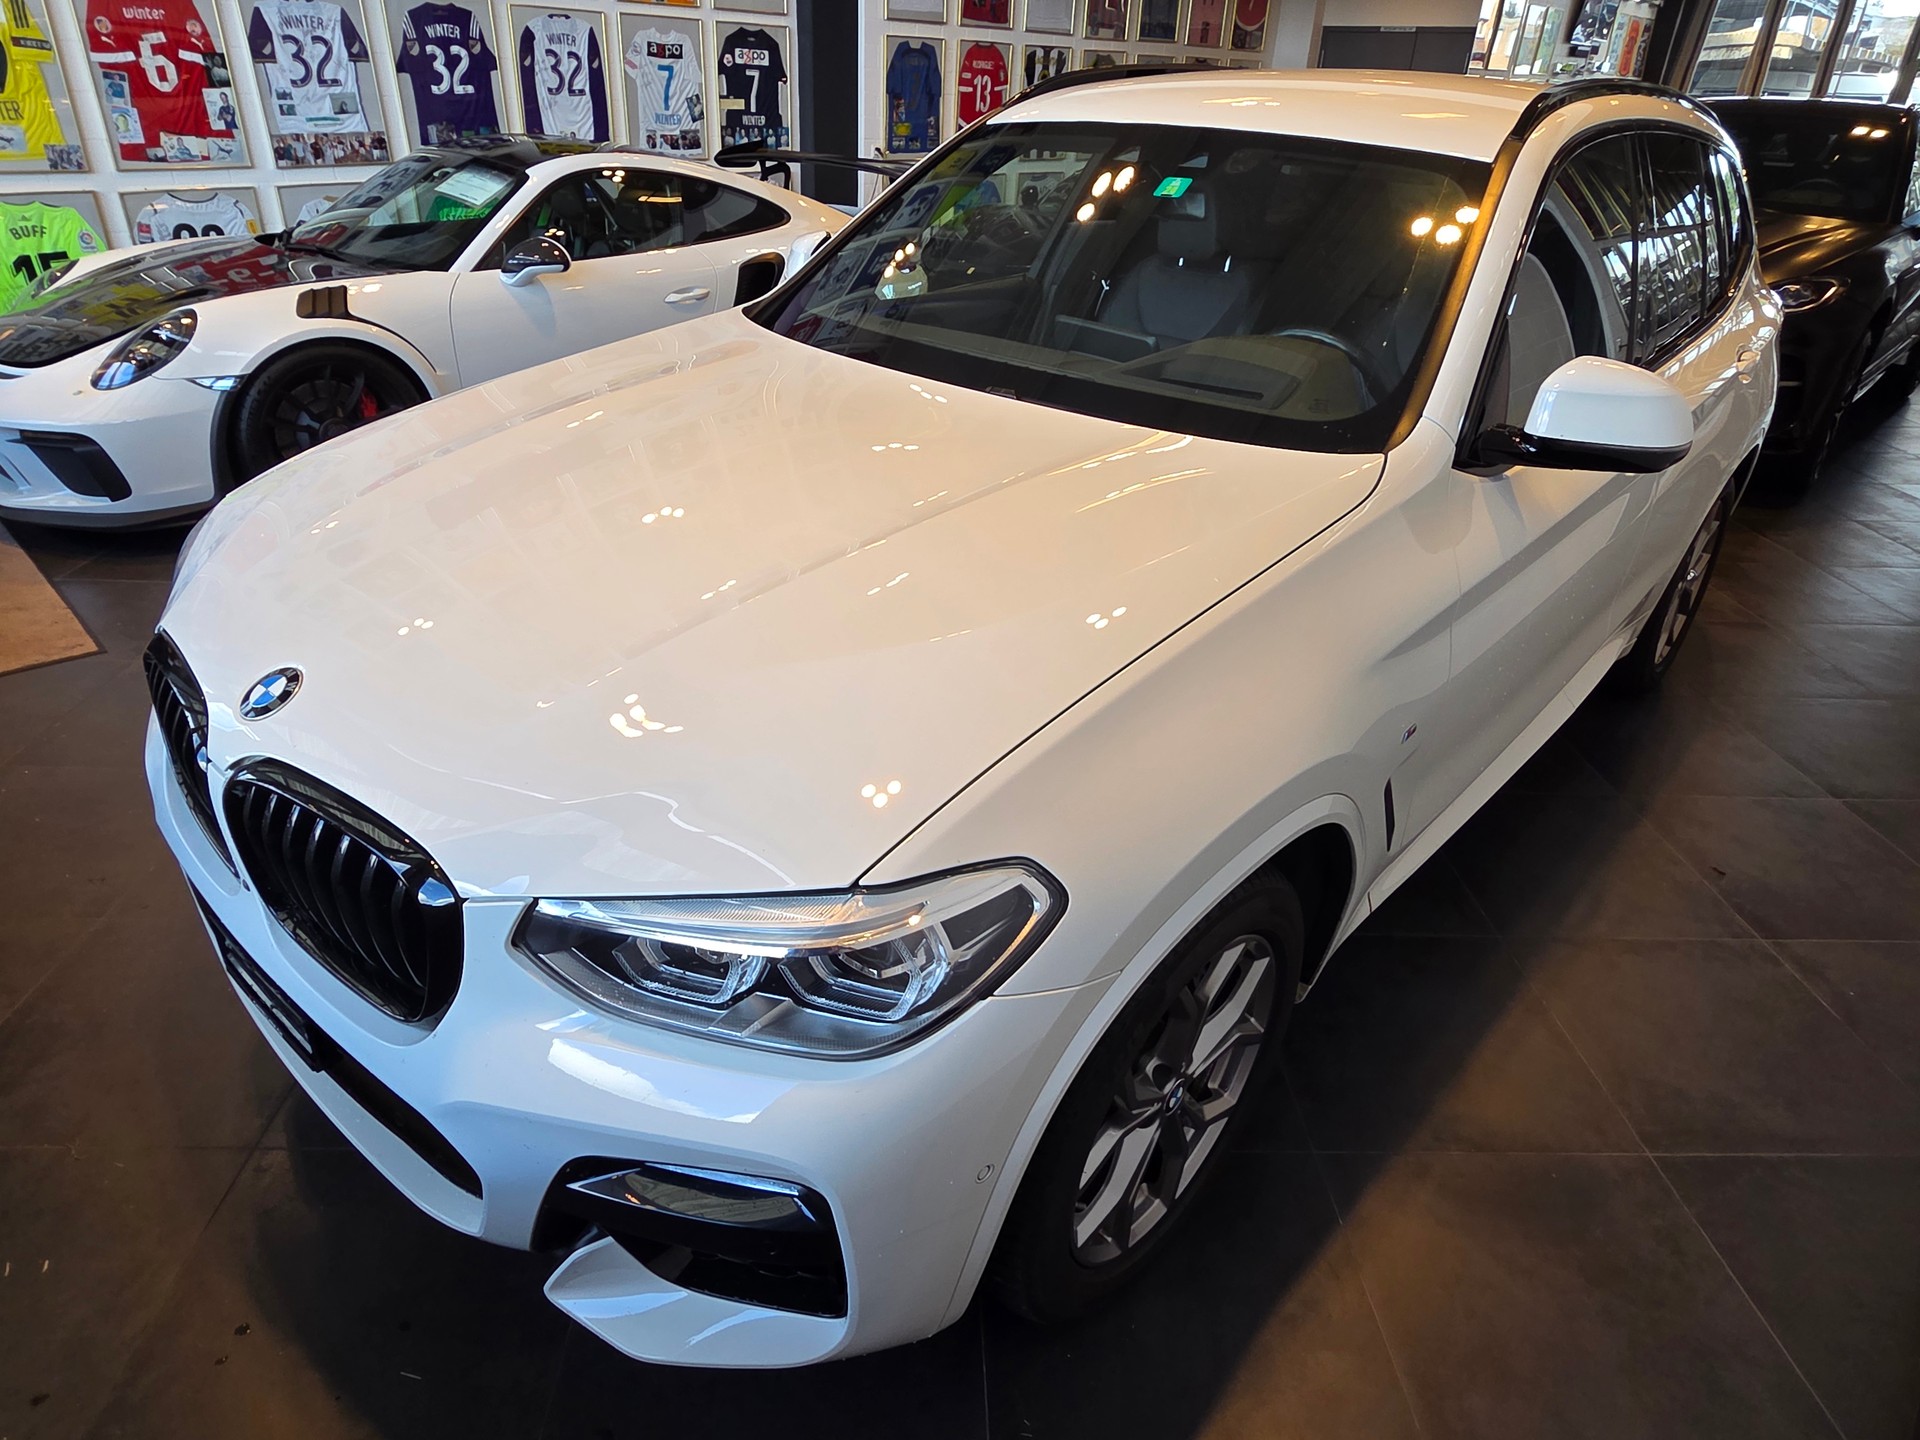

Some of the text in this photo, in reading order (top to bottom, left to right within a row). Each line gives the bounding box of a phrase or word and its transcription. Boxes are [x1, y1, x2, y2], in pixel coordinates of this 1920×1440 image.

[122, 6, 166, 20] winter
[281, 14, 325, 31] WINTER
[424, 23, 461, 39] WINTER
[545, 32, 577, 48] WINTER
[138, 31, 179, 93] 6
[281, 34, 343, 88] 32
[425, 44, 475, 95] 32
[544, 48, 587, 97] 32
[657, 64, 674, 112] 7
[745, 69, 760, 113] 7
[973, 74, 992, 113] 13
[9, 224, 48, 241] BUFF
